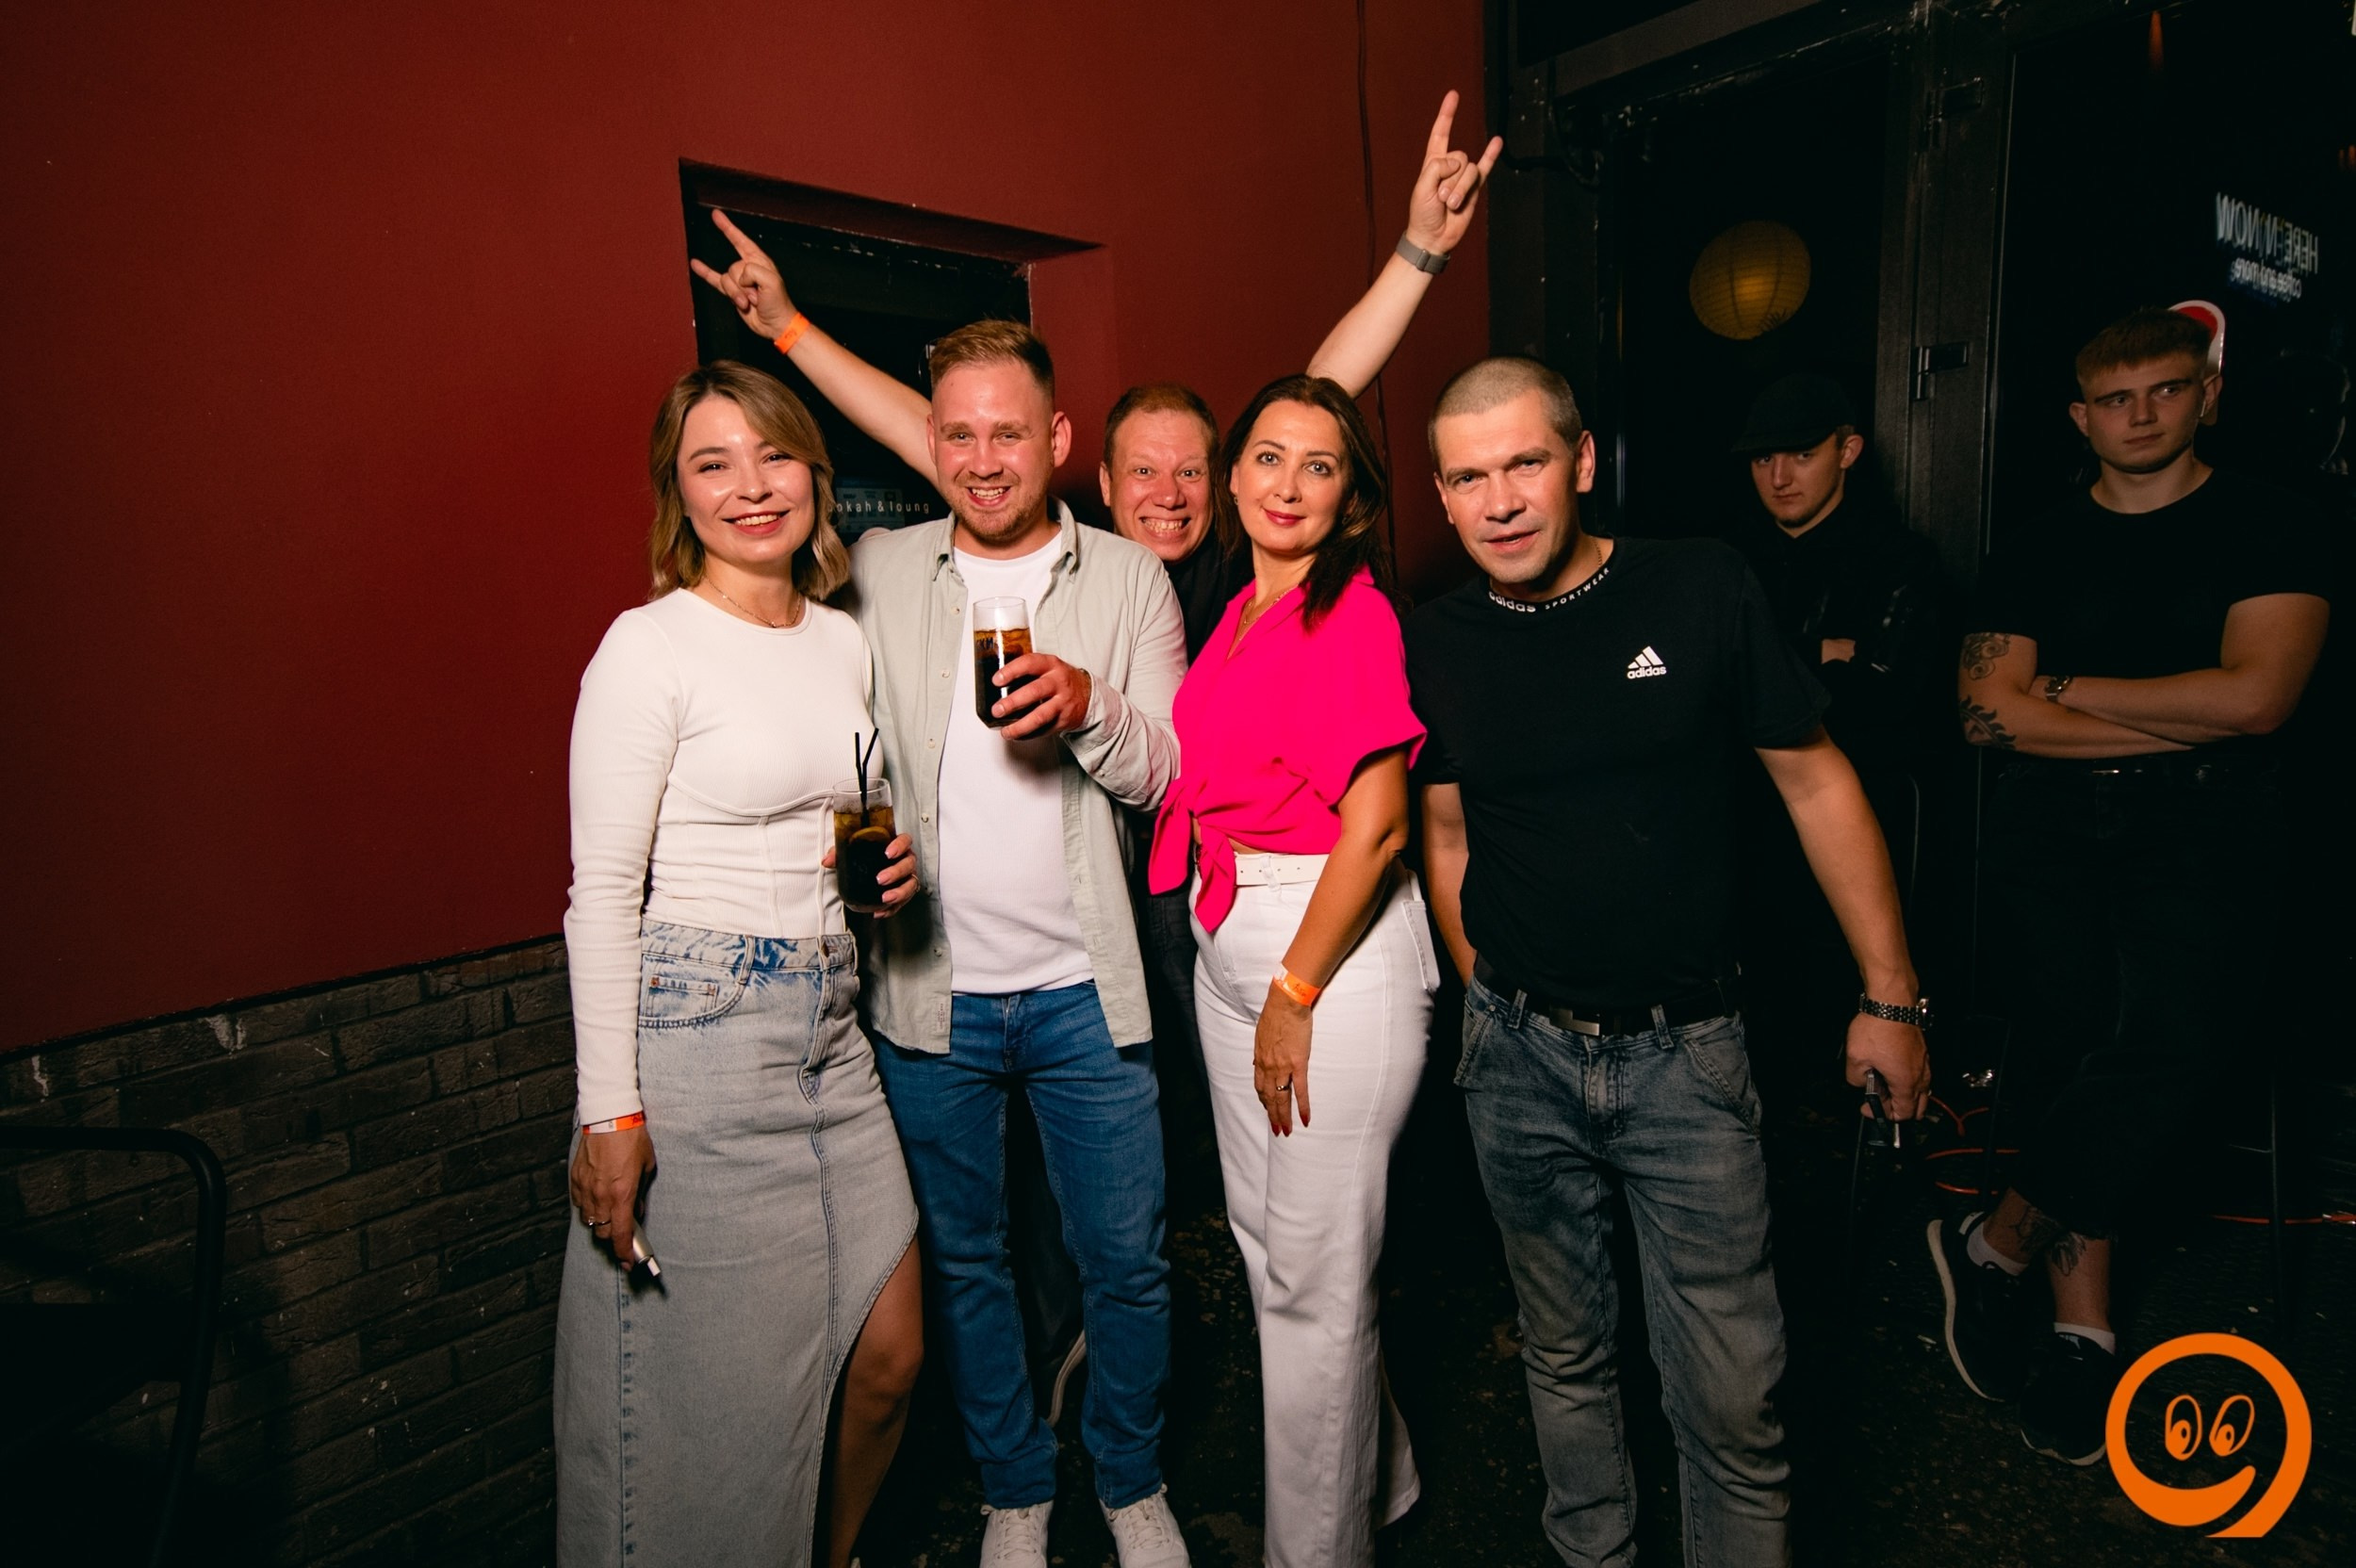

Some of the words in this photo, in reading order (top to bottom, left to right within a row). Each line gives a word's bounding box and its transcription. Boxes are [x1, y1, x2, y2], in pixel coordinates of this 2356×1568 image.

[877, 500, 885, 513] &
[890, 500, 929, 514] loung
[1488, 591, 1536, 612] adidas
[1545, 567, 1610, 611] SPORTWEAR
[1627, 666, 1667, 679] adidas
